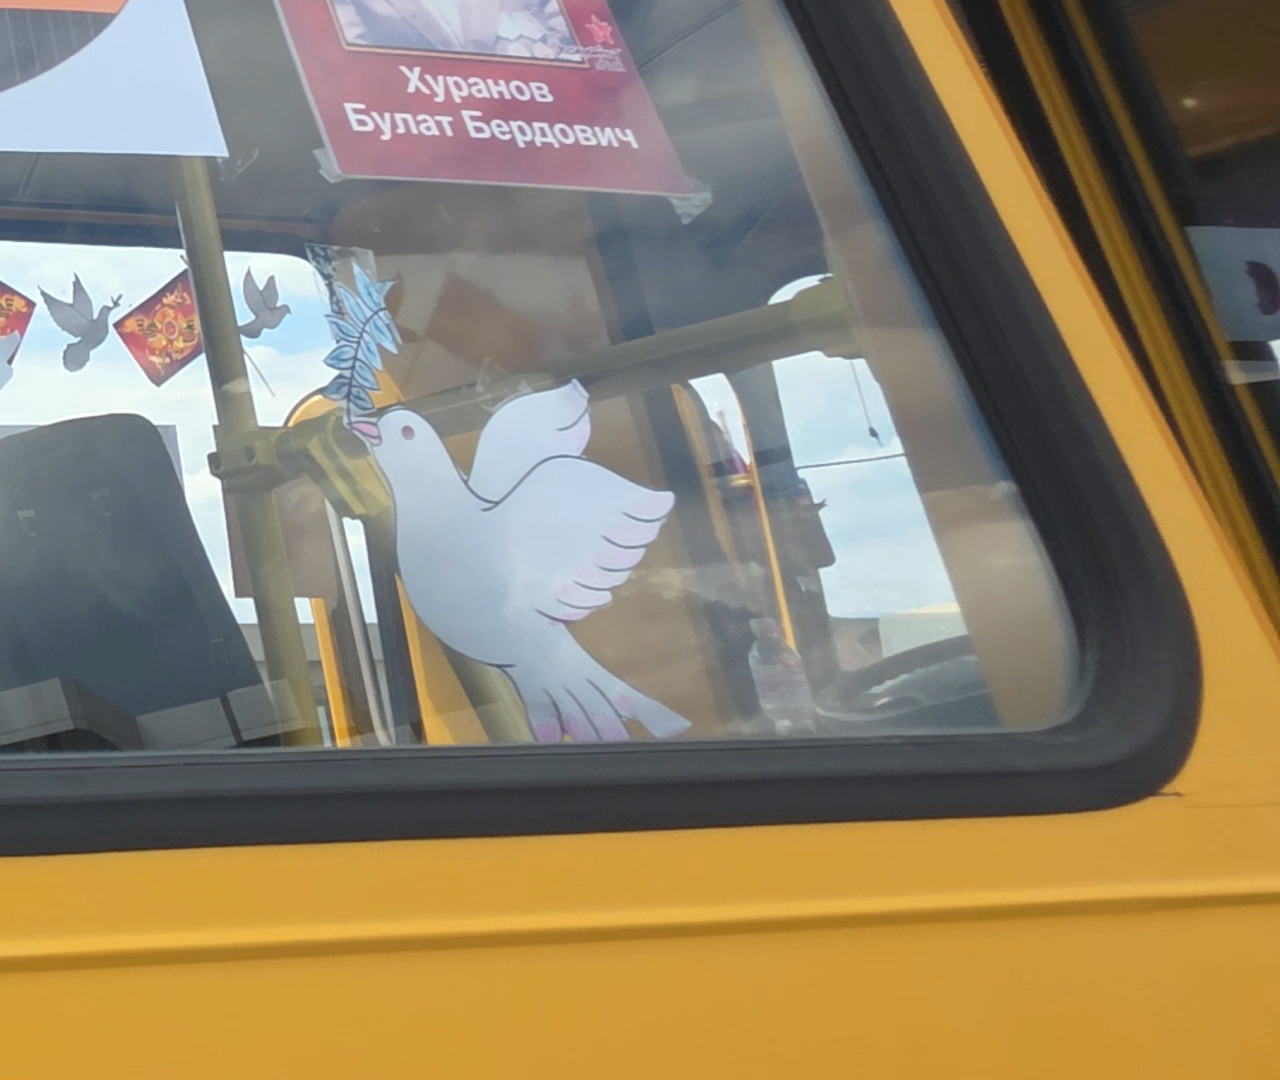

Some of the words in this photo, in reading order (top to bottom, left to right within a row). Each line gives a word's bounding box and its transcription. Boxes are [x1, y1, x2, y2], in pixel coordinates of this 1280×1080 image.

[399, 65, 554, 104] Хуранов
[343, 102, 454, 141] Булат
[460, 109, 639, 149] Бердович
